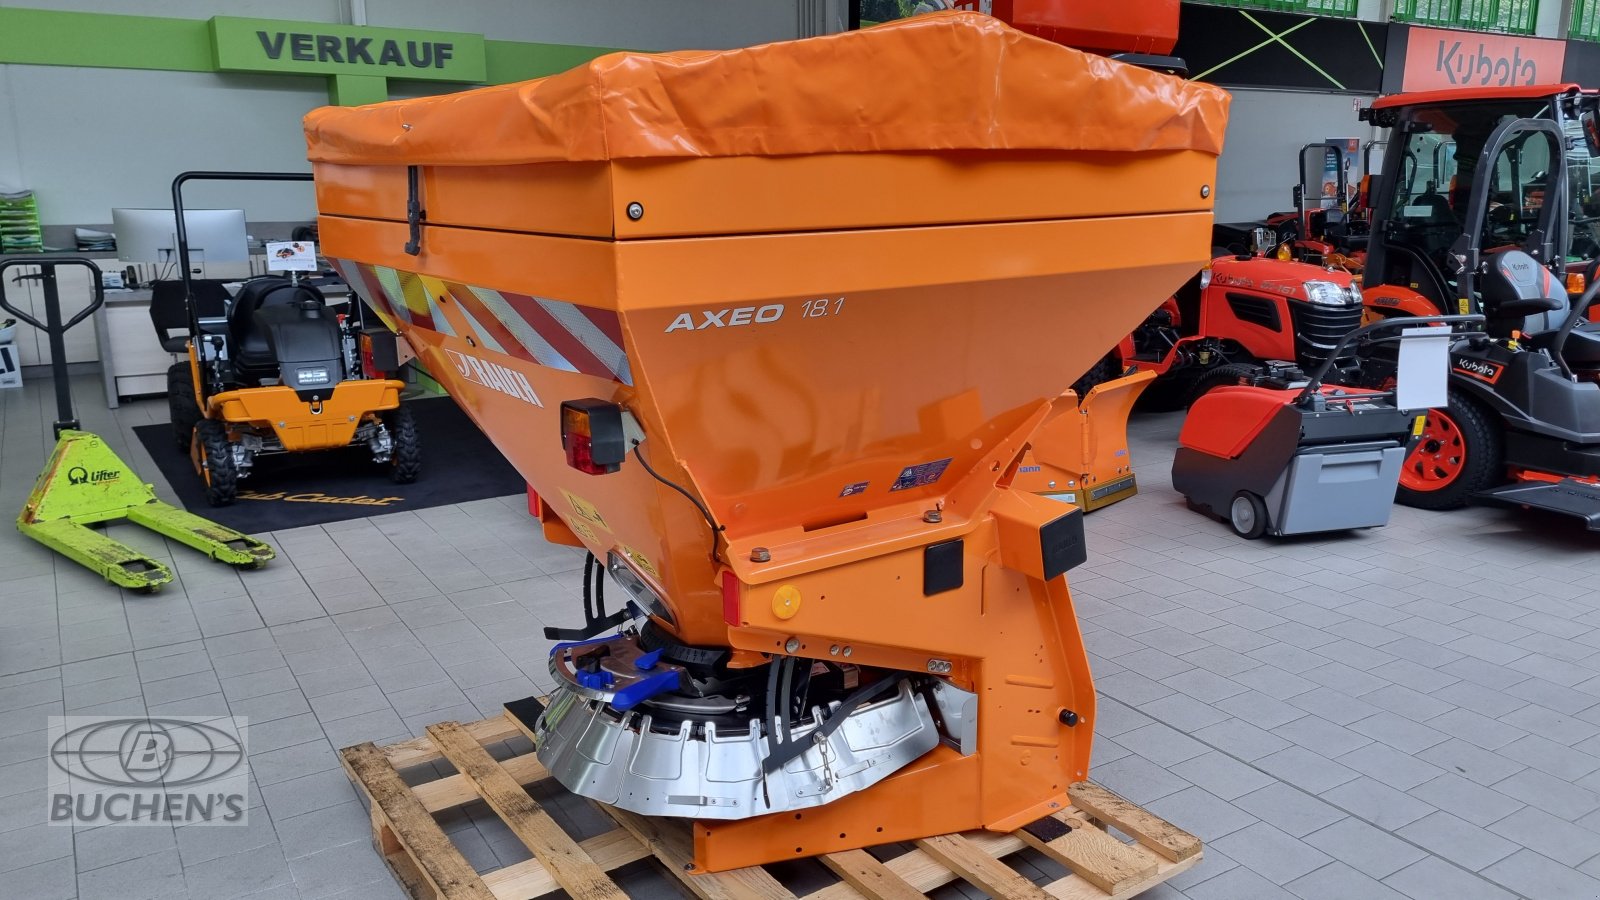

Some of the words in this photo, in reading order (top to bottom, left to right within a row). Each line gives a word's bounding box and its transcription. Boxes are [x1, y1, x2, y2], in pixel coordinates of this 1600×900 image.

[256, 31, 454, 69] VERKAUF
[1436, 40, 1537, 87] Kubota
[664, 304, 785, 333] AXEO
[801, 297, 845, 319] 18.1
[1459, 358, 1494, 376] Kubota
[465, 355, 545, 408] RAUCH
[91, 470, 121, 482] Lifter
[1019, 465, 1041, 473] ann
[284, 493, 405, 506] Cadet
